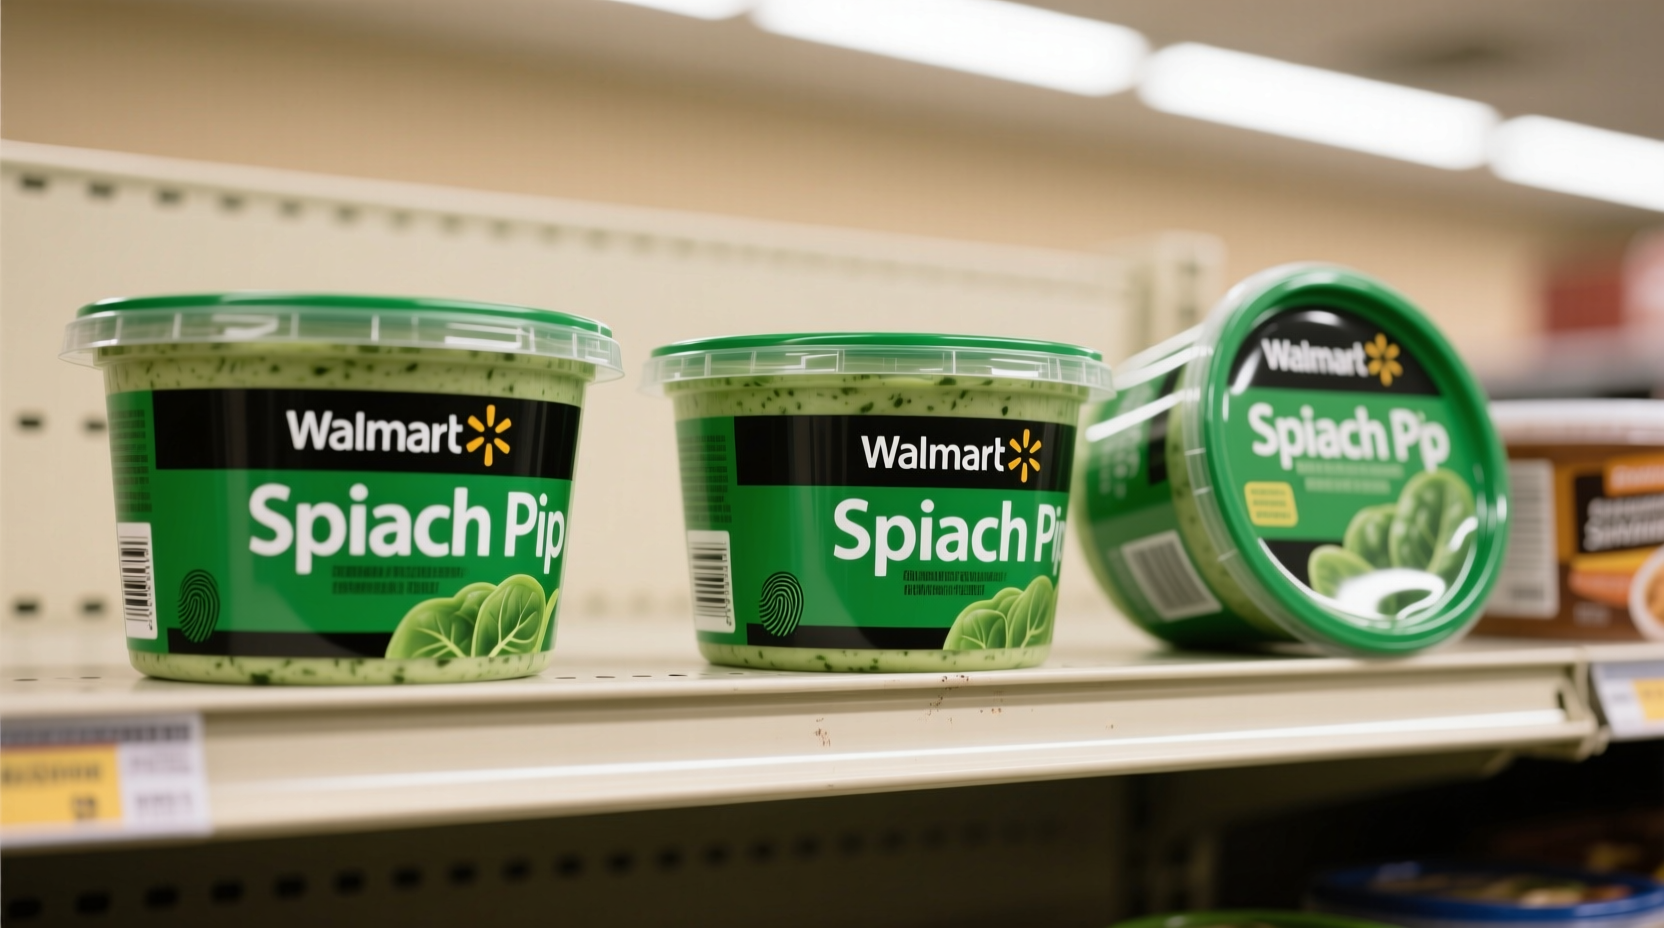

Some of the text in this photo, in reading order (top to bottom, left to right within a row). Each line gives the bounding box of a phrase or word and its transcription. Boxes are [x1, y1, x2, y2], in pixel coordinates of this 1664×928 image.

[1260, 337, 1369, 378] Walmart
[286, 410, 464, 455] Walmart
[860, 435, 1006, 472] Walmart
[1247, 401, 1390, 470] Spiach
[248, 483, 566, 575] Spiach Pip
[833, 497, 1028, 577] Spiach
